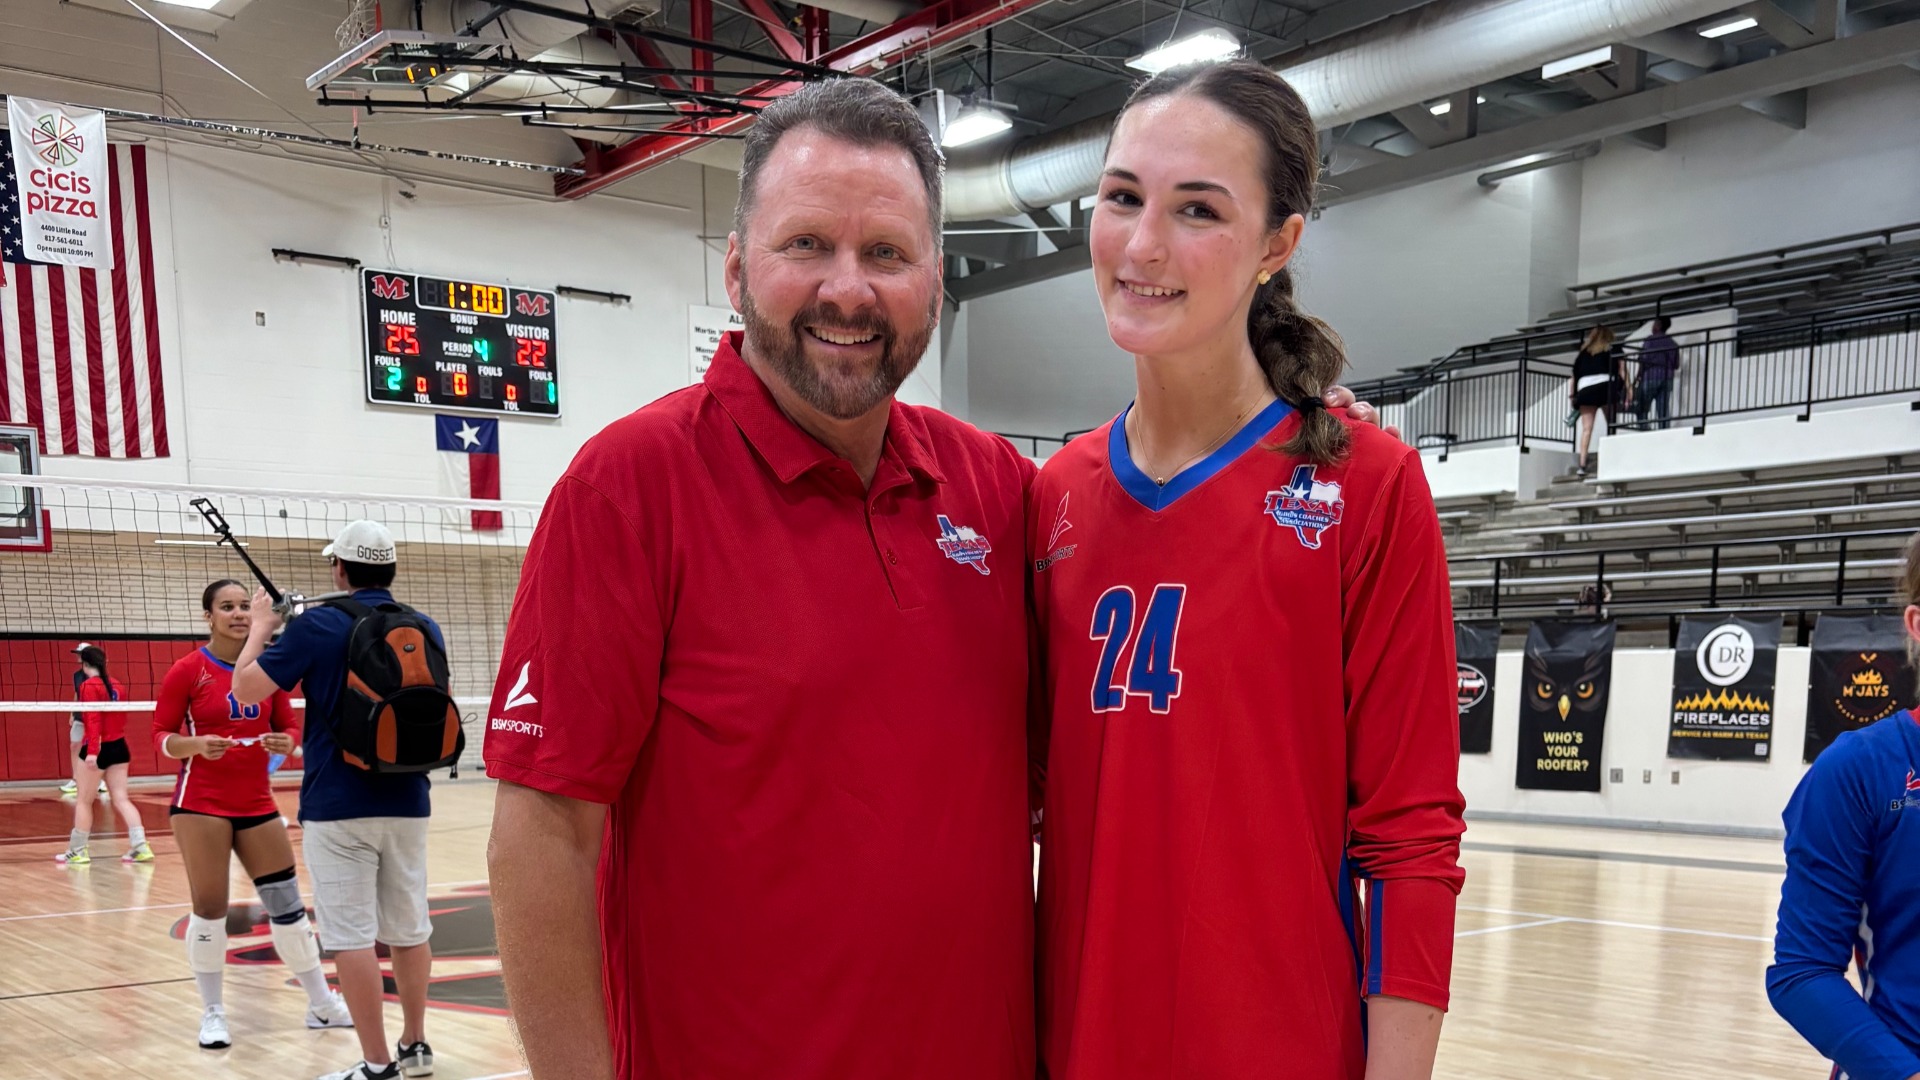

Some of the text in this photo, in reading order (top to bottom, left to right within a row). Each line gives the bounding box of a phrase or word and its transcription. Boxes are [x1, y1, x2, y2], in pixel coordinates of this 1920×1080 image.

[30, 167, 91, 195] cicis
[27, 190, 98, 219] pizza
[41, 224, 87, 237] 4400 Little Road
[37, 244, 52, 253] Open
[67, 247, 84, 257] 10:00
[84, 249, 94, 258] PM
[371, 274, 410, 300] M
[448, 282, 504, 315] 1:00
[515, 292, 551, 317] M
[380, 309, 417, 326] HOME
[450, 313, 479, 326] BONUS
[386, 324, 420, 355] 25
[505, 323, 550, 341] VISITOR
[442, 341, 474, 354] PERIOD
[474, 339, 489, 362] 4
[516, 338, 547, 368] 22
[374, 355, 401, 367] FOULS
[435, 361, 468, 374] PLAYER
[387, 366, 402, 391] 2
[478, 365, 503, 377] FOULS
[529, 370, 553, 381] FOULS
[416, 376, 427, 393] 0
[453, 372, 468, 396] 0
[506, 384, 517, 401] 0
[547, 381, 556, 404] 1
[413, 392, 432, 404] TOL
[503, 400, 520, 411] TOL
[1264, 495, 1344, 523] TEXAS
[1089, 582, 1187, 715] 24
[1673, 711, 1771, 726] FIREPLACES
[1543, 731, 1584, 744] WHO'S
[1547, 746, 1579, 758] YOUR
[1537, 759, 1589, 771] ROOFER?
